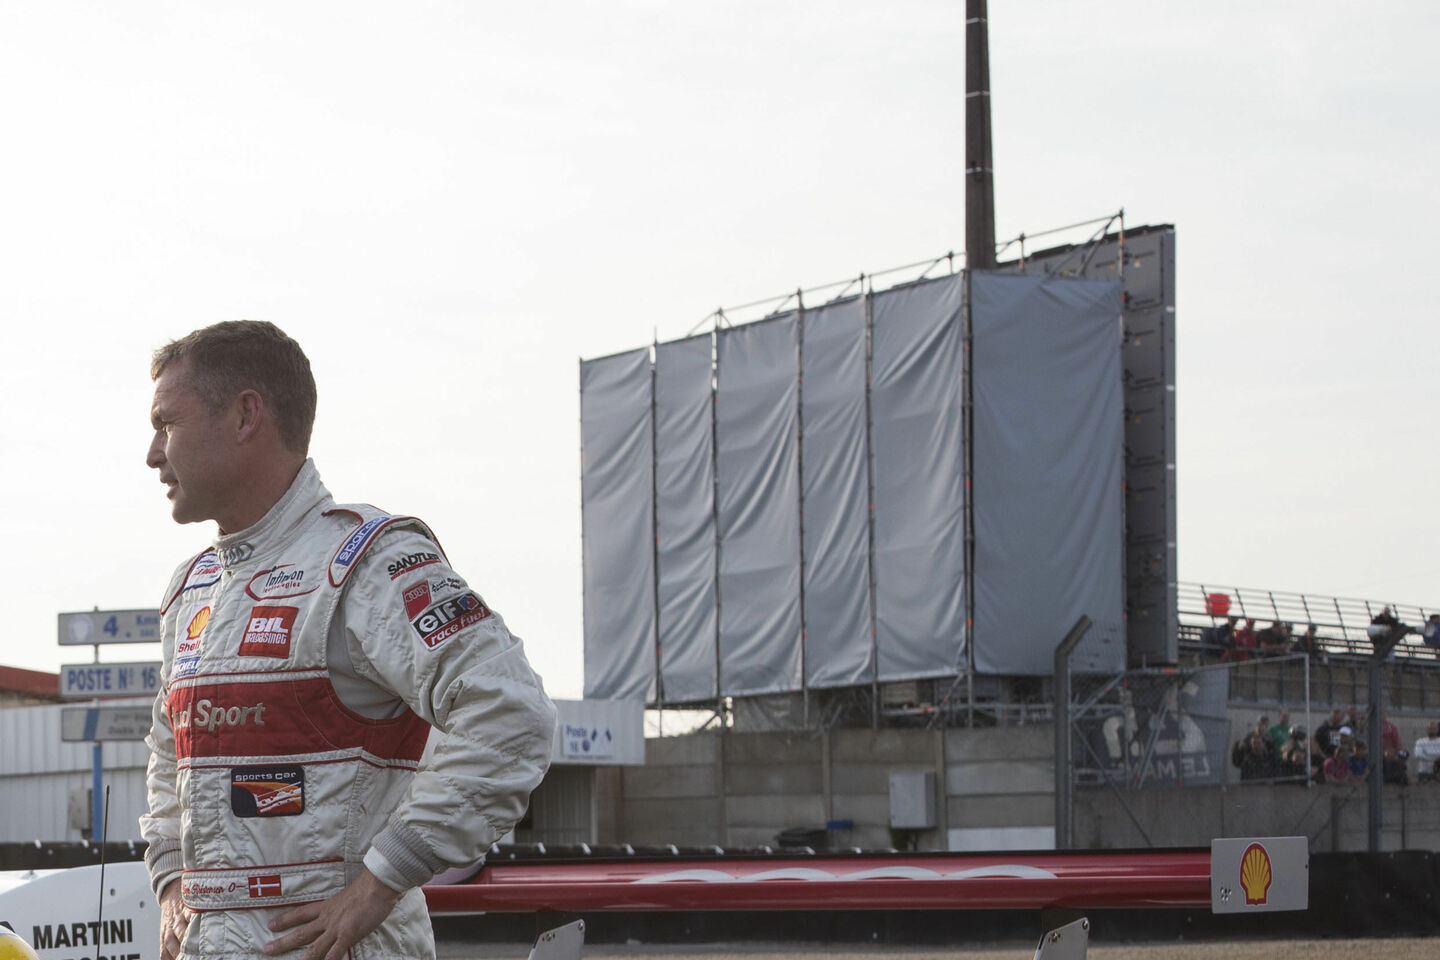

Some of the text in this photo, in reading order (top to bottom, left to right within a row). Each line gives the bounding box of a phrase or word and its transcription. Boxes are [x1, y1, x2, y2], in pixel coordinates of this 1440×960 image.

[248, 617, 288, 633] BIL
[419, 602, 457, 633] elf
[431, 623, 459, 646] race
[178, 640, 201, 653] Shell
[67, 668, 111, 691] POSTE
[141, 667, 156, 689] 16
[194, 699, 266, 732] Sport
[235, 773, 272, 782] sports
[33, 919, 133, 950] MARTINI
